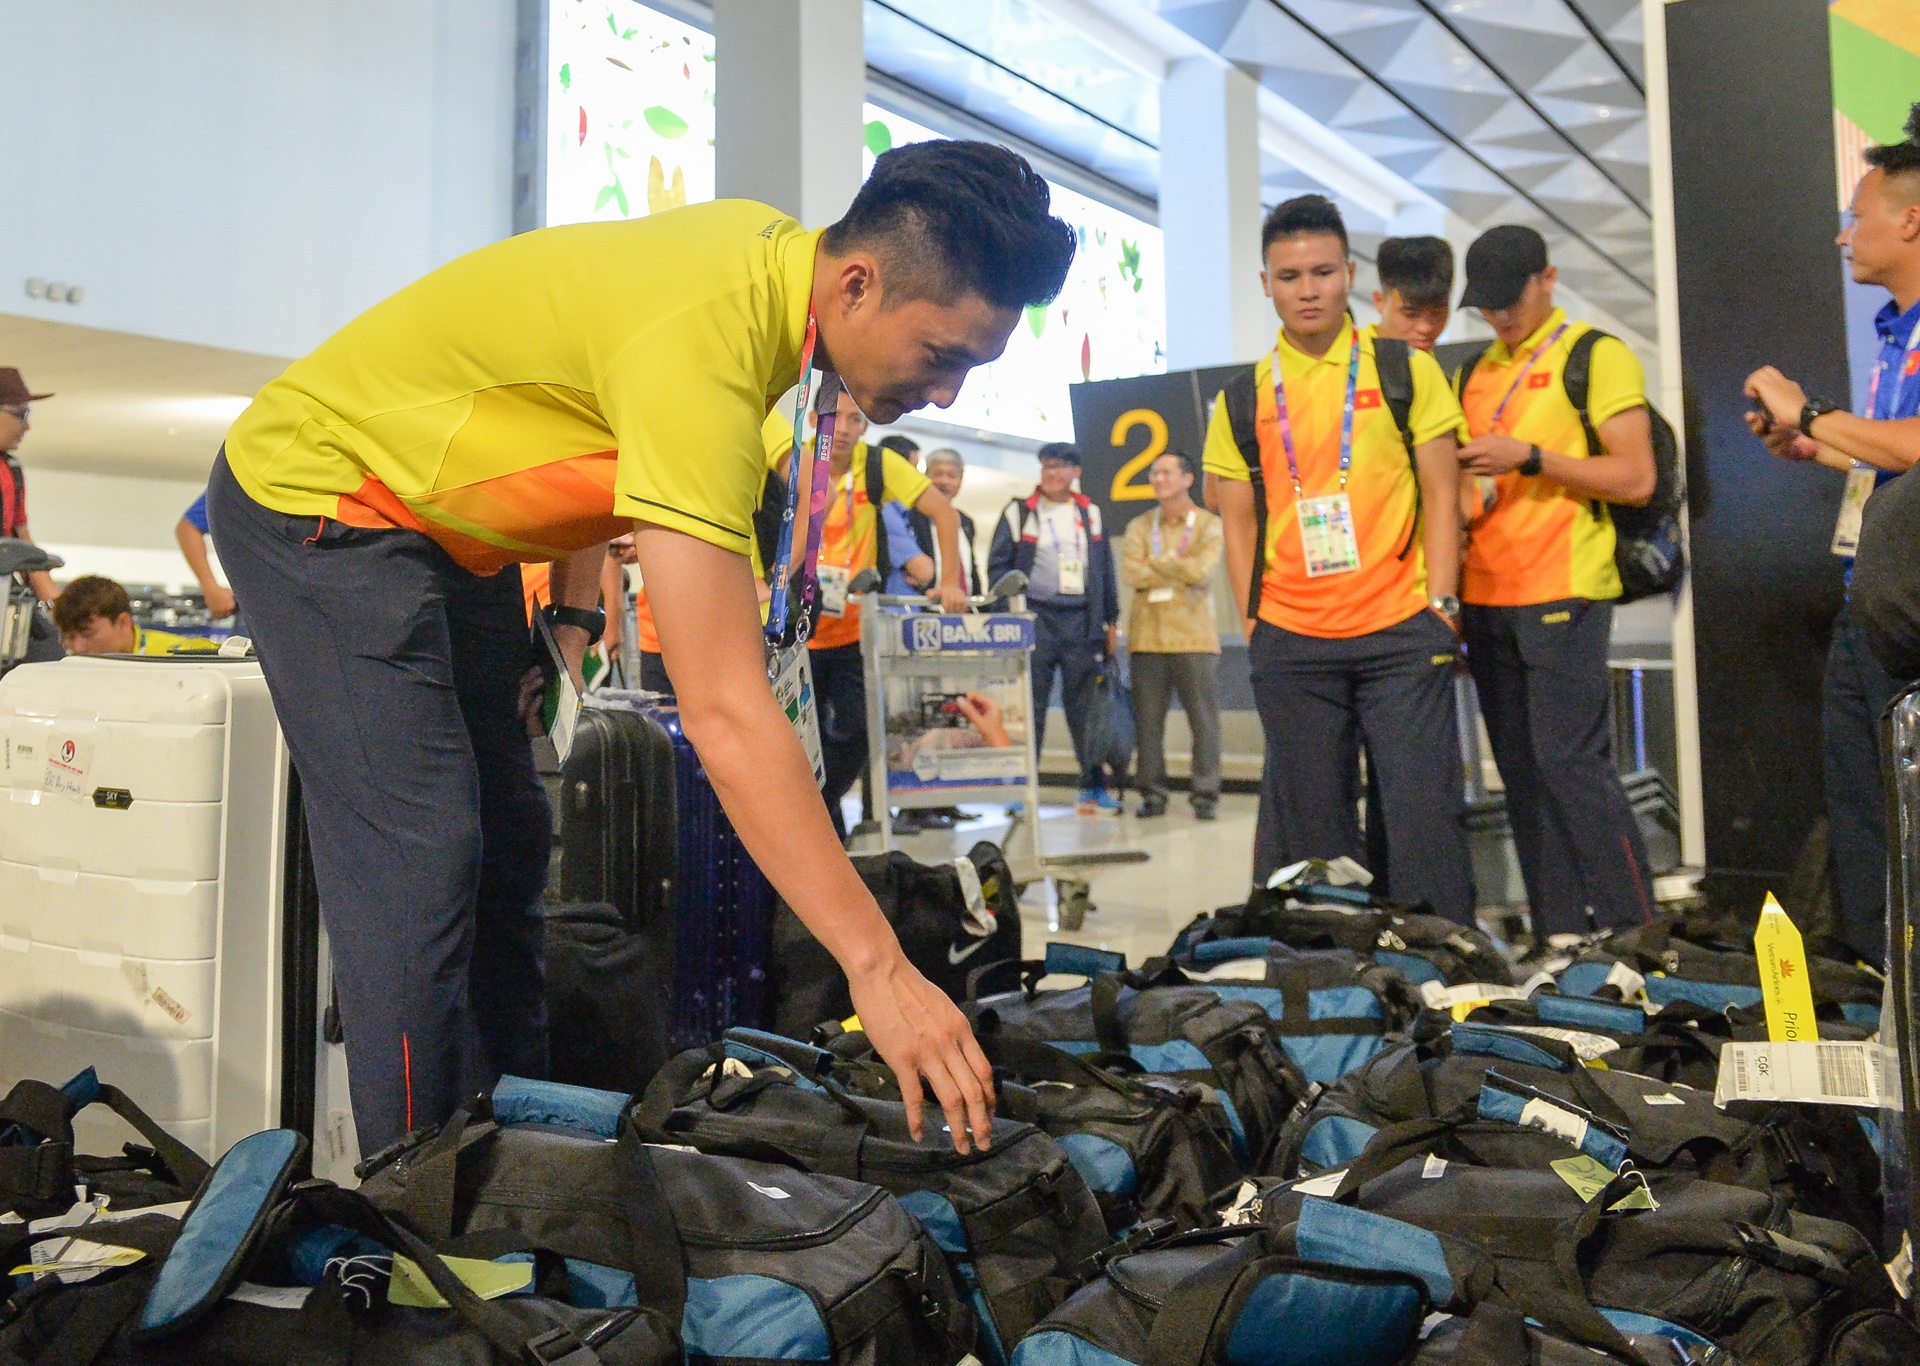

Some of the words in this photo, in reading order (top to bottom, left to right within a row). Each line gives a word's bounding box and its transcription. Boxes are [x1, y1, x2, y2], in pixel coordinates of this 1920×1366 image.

[1110, 408, 1169, 502] 2
[993, 624, 1022, 642] BRI
[1757, 1056, 1769, 1077] CGK
